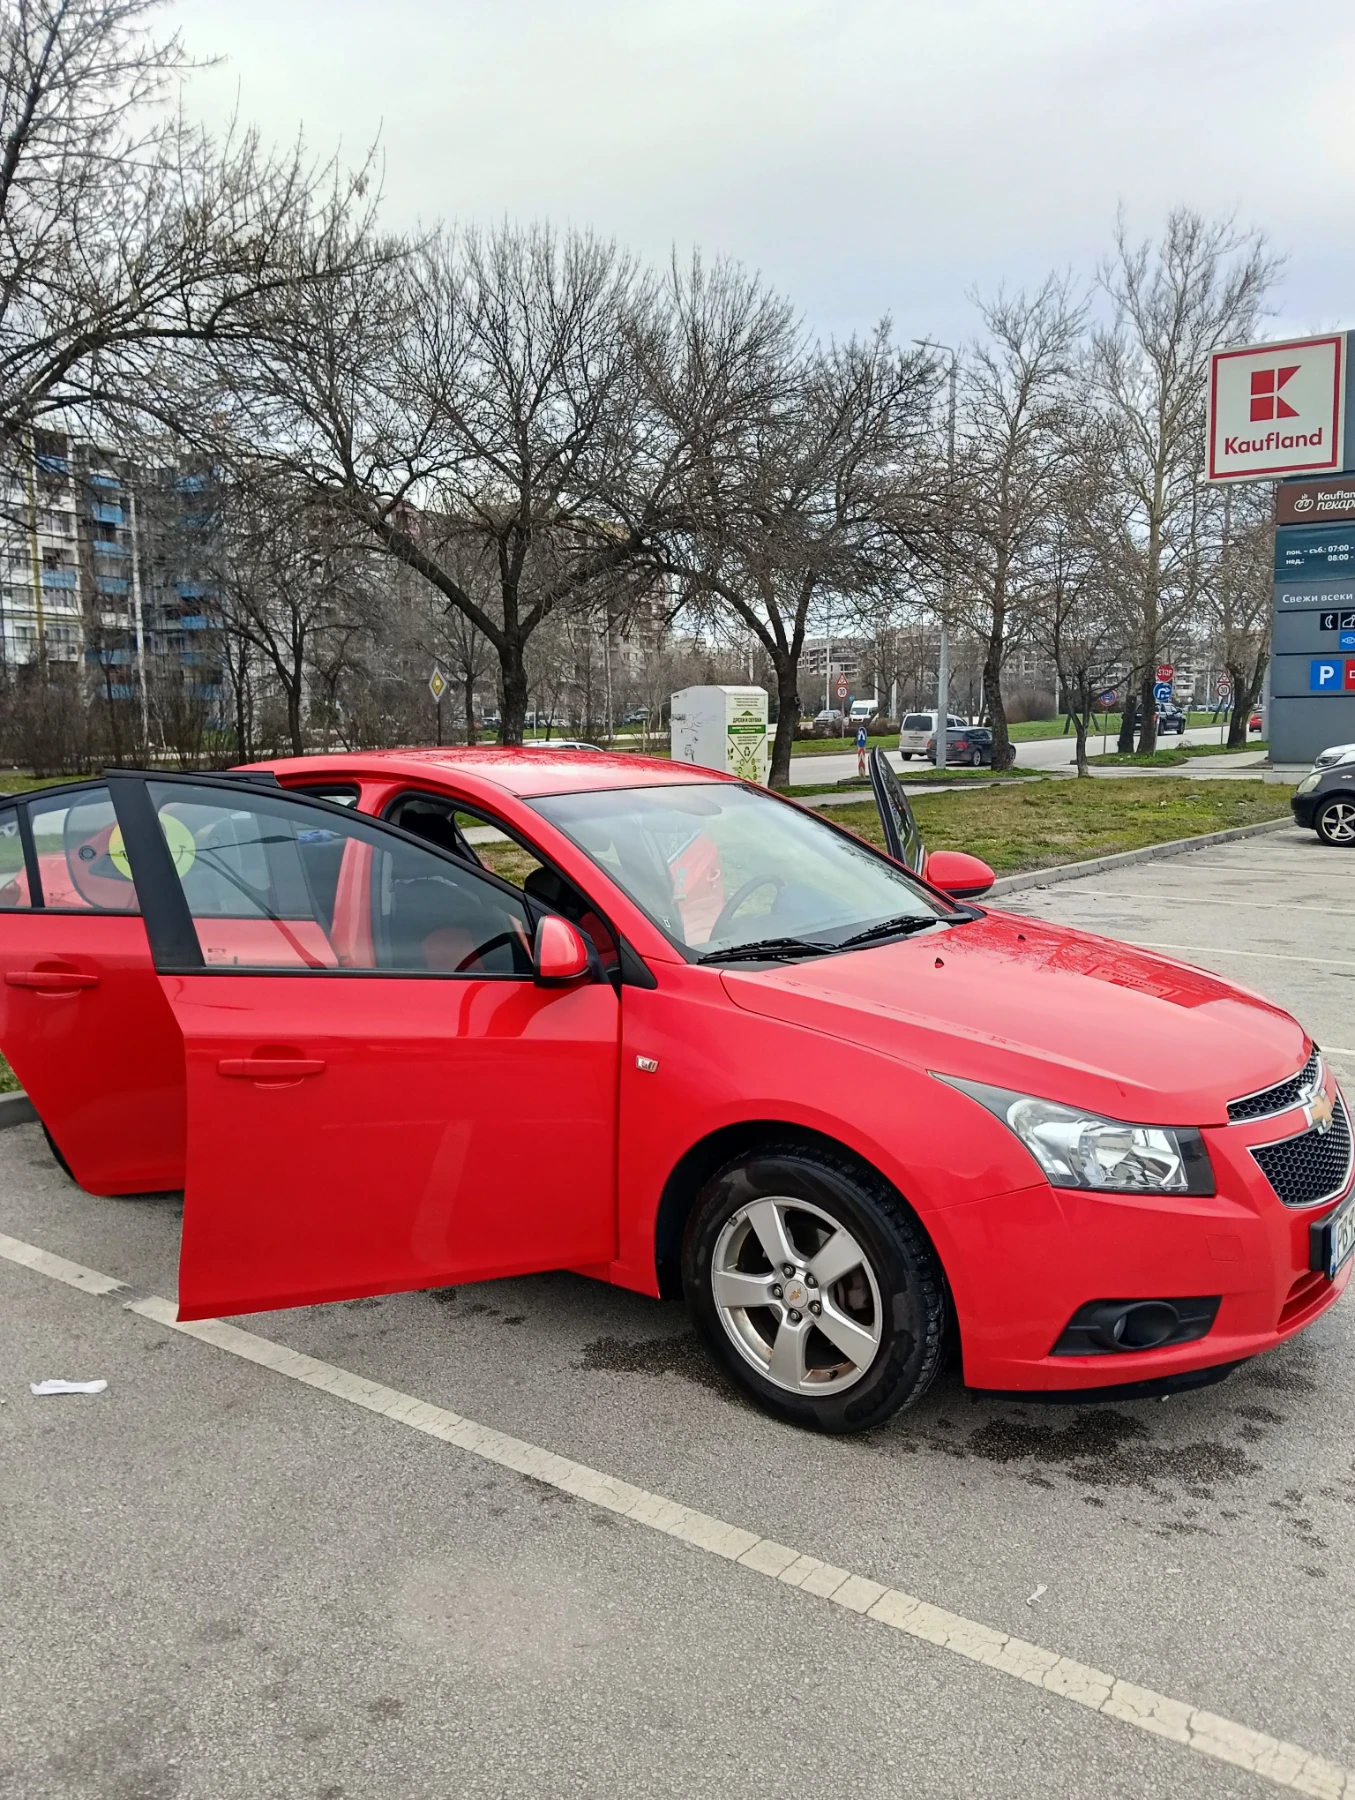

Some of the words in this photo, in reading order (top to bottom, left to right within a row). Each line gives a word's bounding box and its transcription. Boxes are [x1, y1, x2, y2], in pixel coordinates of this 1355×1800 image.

[1224, 427, 1323, 455] Kaufland
[1316, 499, 1355, 511] пекар
[1328, 544, 1349, 553] 07:00
[1327, 554, 1349, 562] 08:00
[1282, 594, 1318, 603] Свежи
[1321, 592, 1353, 601] всеки
[1319, 665, 1335, 685] P
